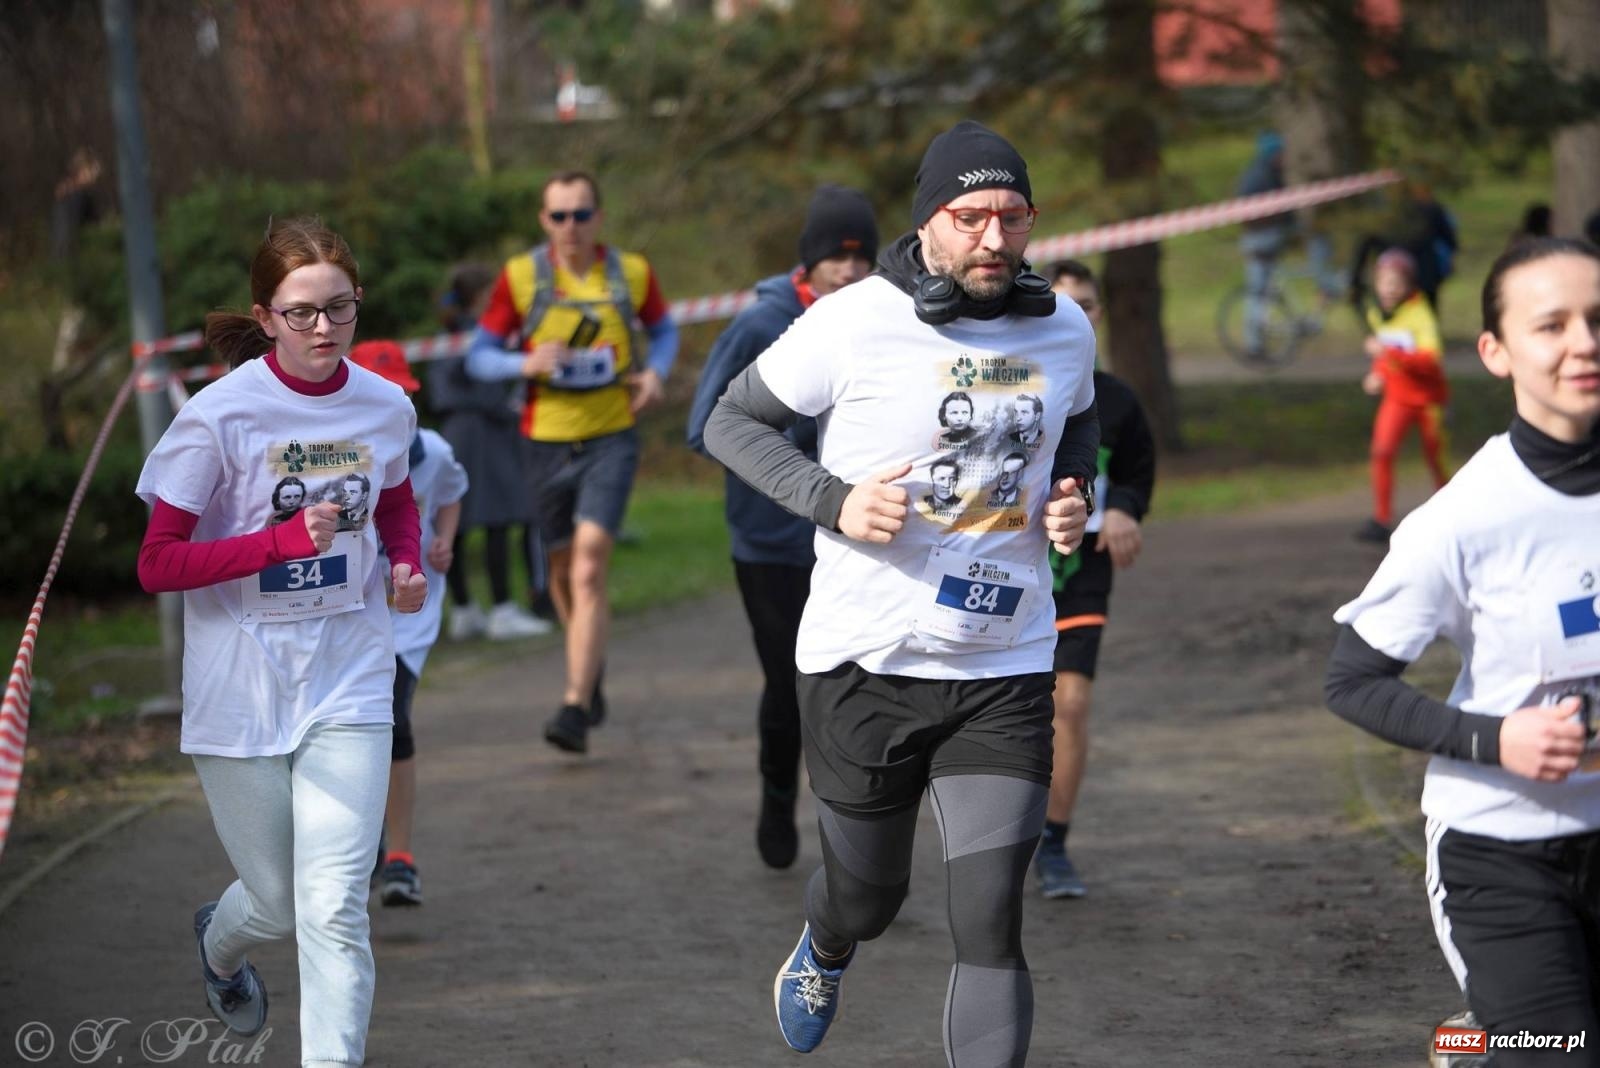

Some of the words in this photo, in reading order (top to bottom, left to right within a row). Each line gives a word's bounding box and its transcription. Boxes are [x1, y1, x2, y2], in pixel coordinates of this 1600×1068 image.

[980, 358, 1007, 367] TROPEM
[981, 368, 1029, 382] WILCZYM
[308, 443, 334, 452] TROPEM
[309, 451, 359, 466] WILCZYM
[287, 560, 323, 589] 34
[982, 569, 1010, 581] WILCZYM
[964, 583, 1000, 612] 84
